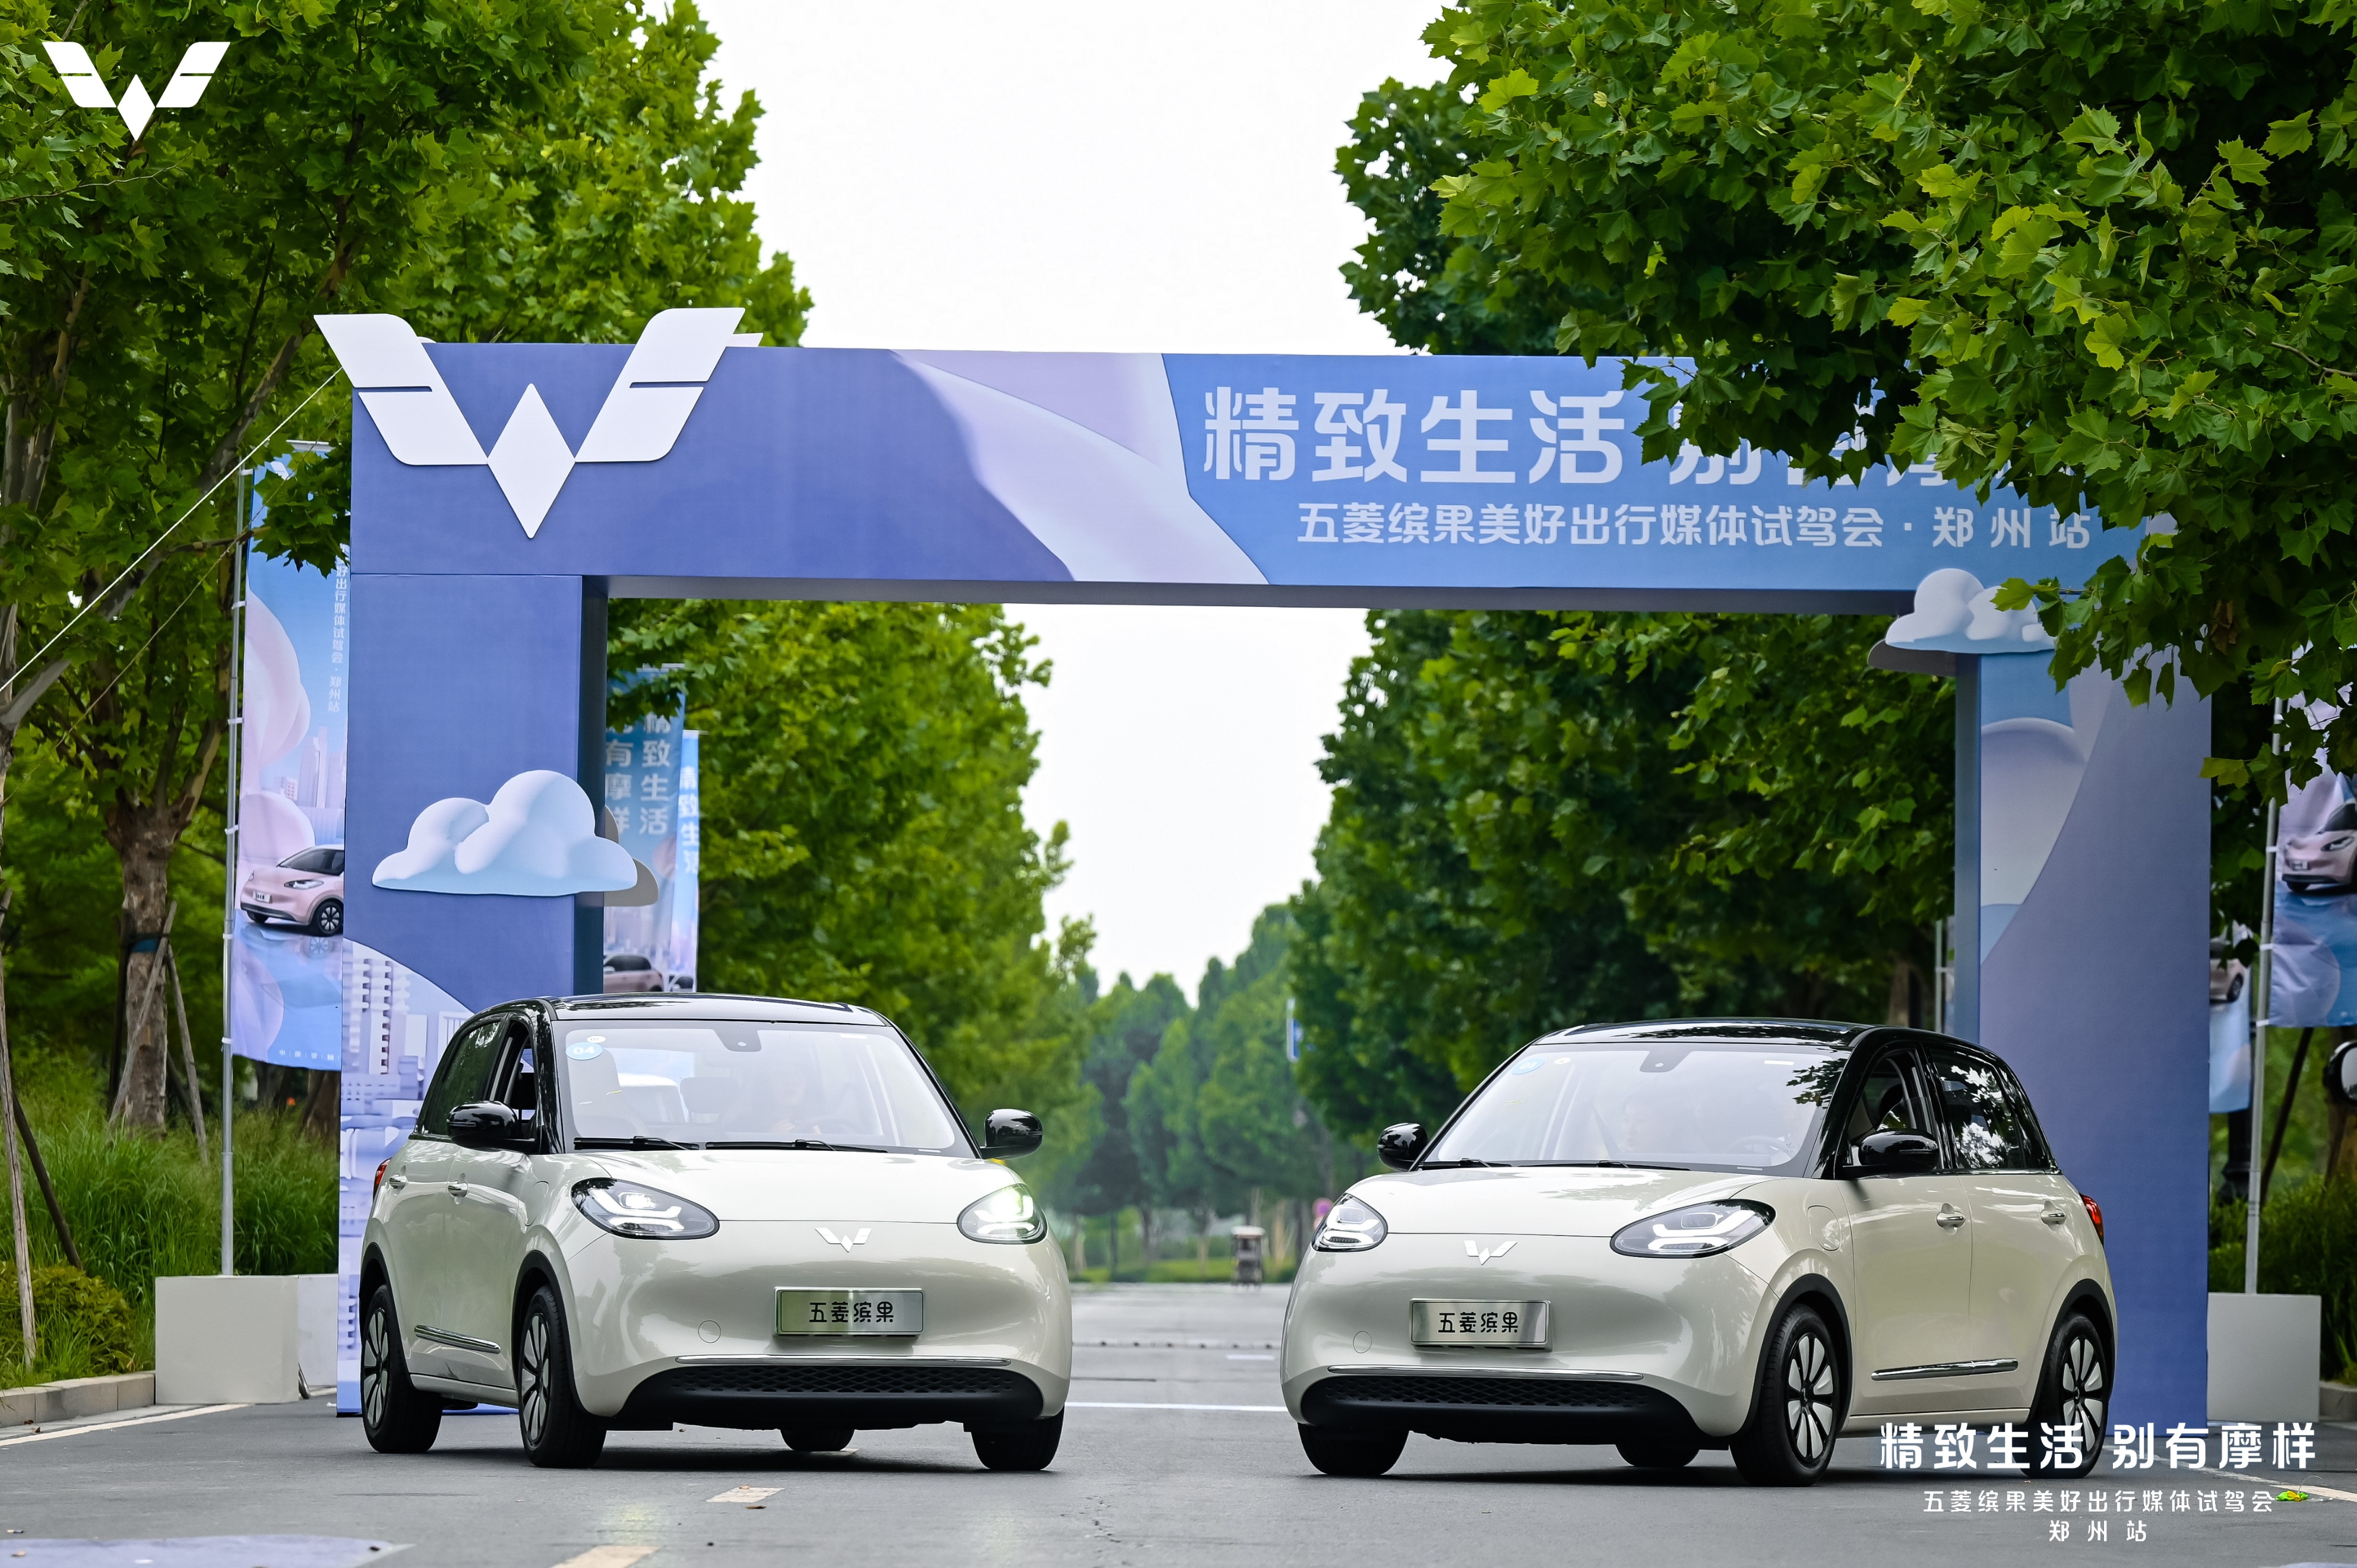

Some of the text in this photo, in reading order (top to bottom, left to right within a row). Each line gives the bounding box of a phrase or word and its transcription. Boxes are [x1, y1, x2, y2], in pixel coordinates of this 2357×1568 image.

[1203, 387, 1625, 485] 精致生活
[573, 1046, 595, 1054] 04
[809, 1301, 894, 1323] 五菱缤果
[1438, 1311, 1518, 1333] 五菱缤果
